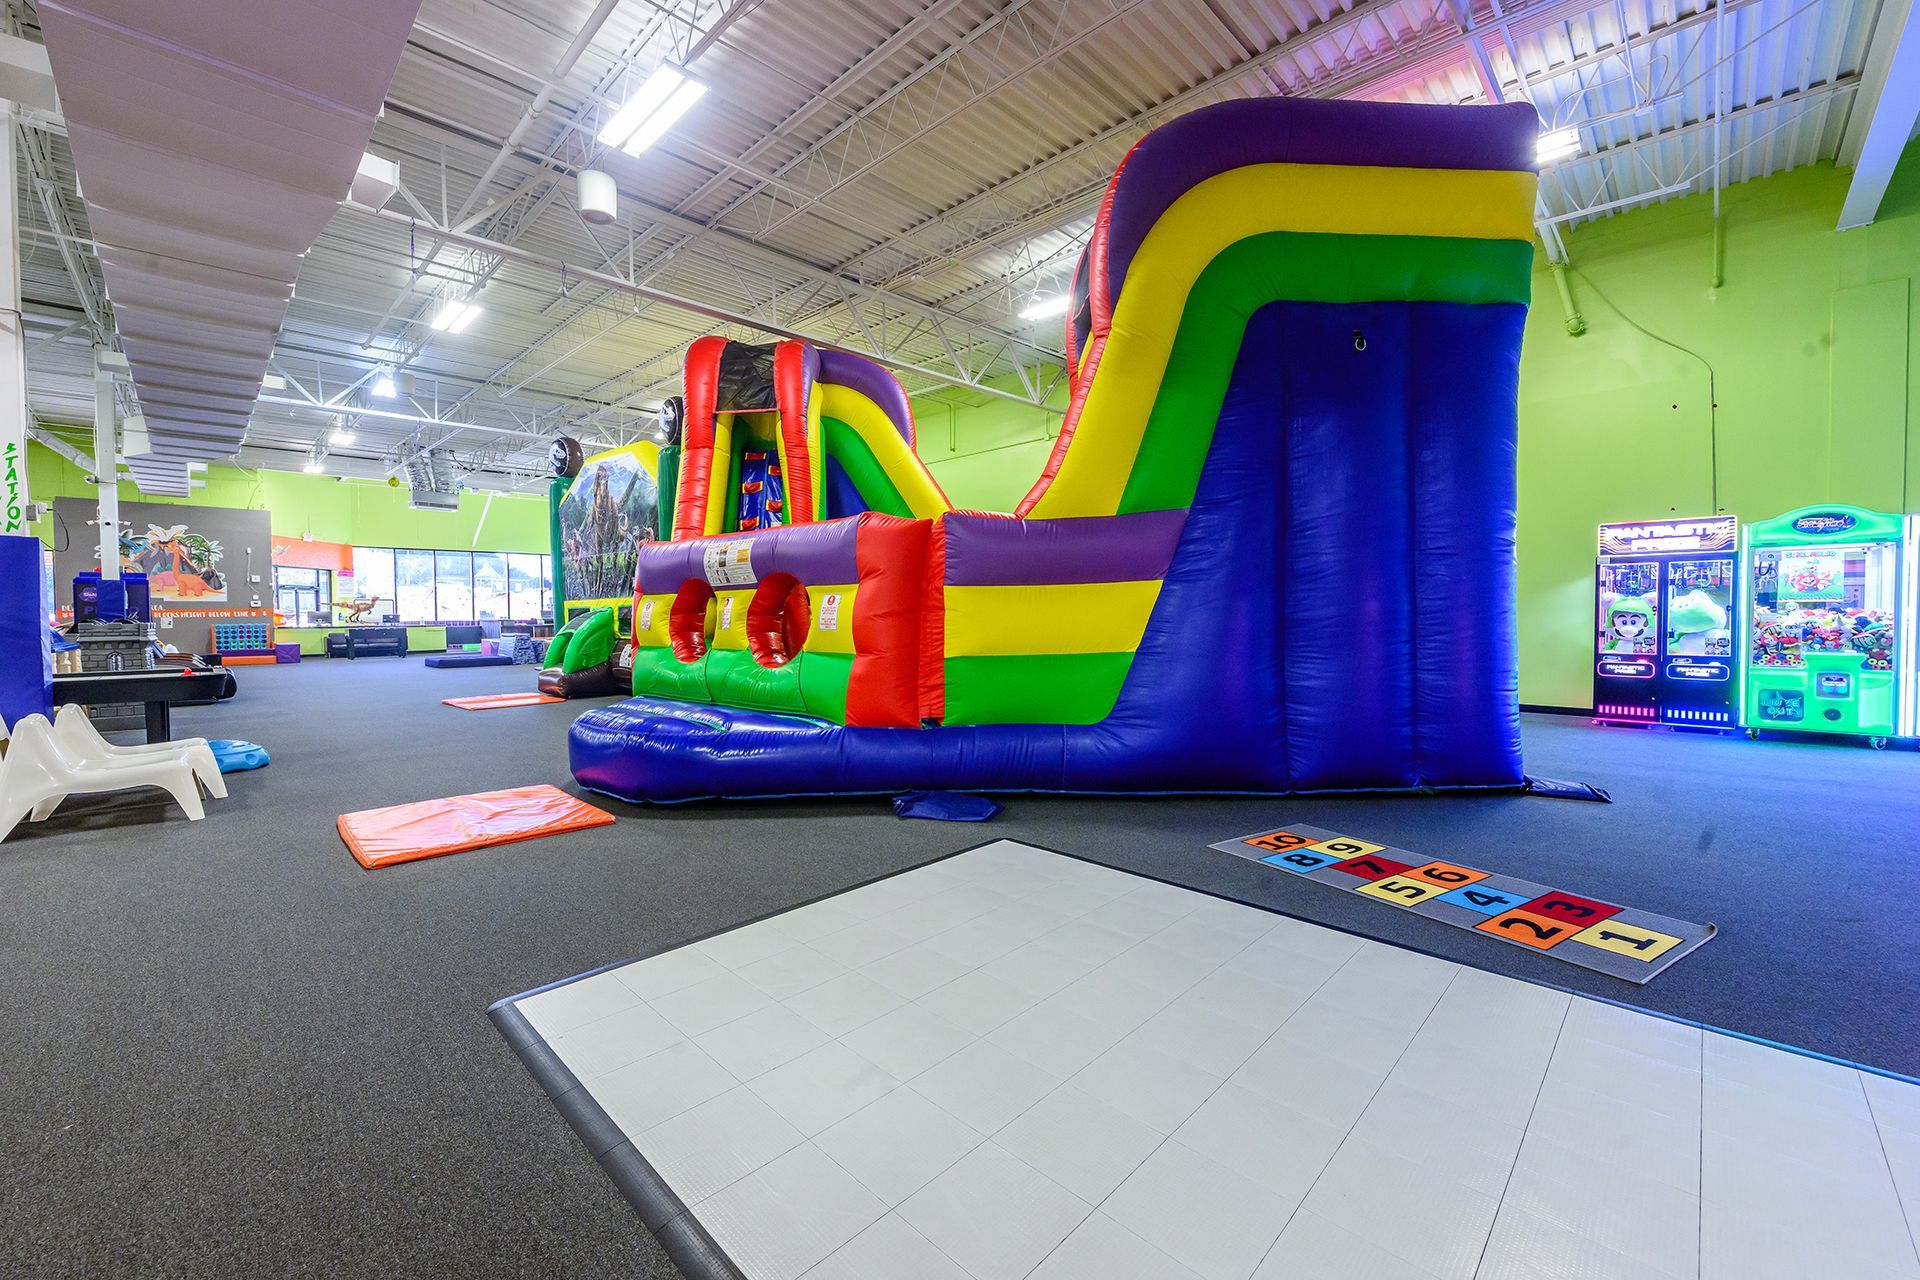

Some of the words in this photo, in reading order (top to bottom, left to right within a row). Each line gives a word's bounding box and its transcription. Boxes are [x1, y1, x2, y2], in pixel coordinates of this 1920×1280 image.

[3, 443, 21, 533] STATION
[1256, 834, 1306, 850] 10
[1326, 843, 1363, 854] 9
[1282, 853, 1325, 867] 8
[1350, 859, 1386, 875] 7
[1423, 867, 1470, 883] 6
[1378, 881, 1427, 898] 5
[1462, 890, 1511, 907] 4
[1543, 900, 1597, 919] 3
[1498, 917, 1563, 940] 2
[1599, 930, 1658, 951] 1
